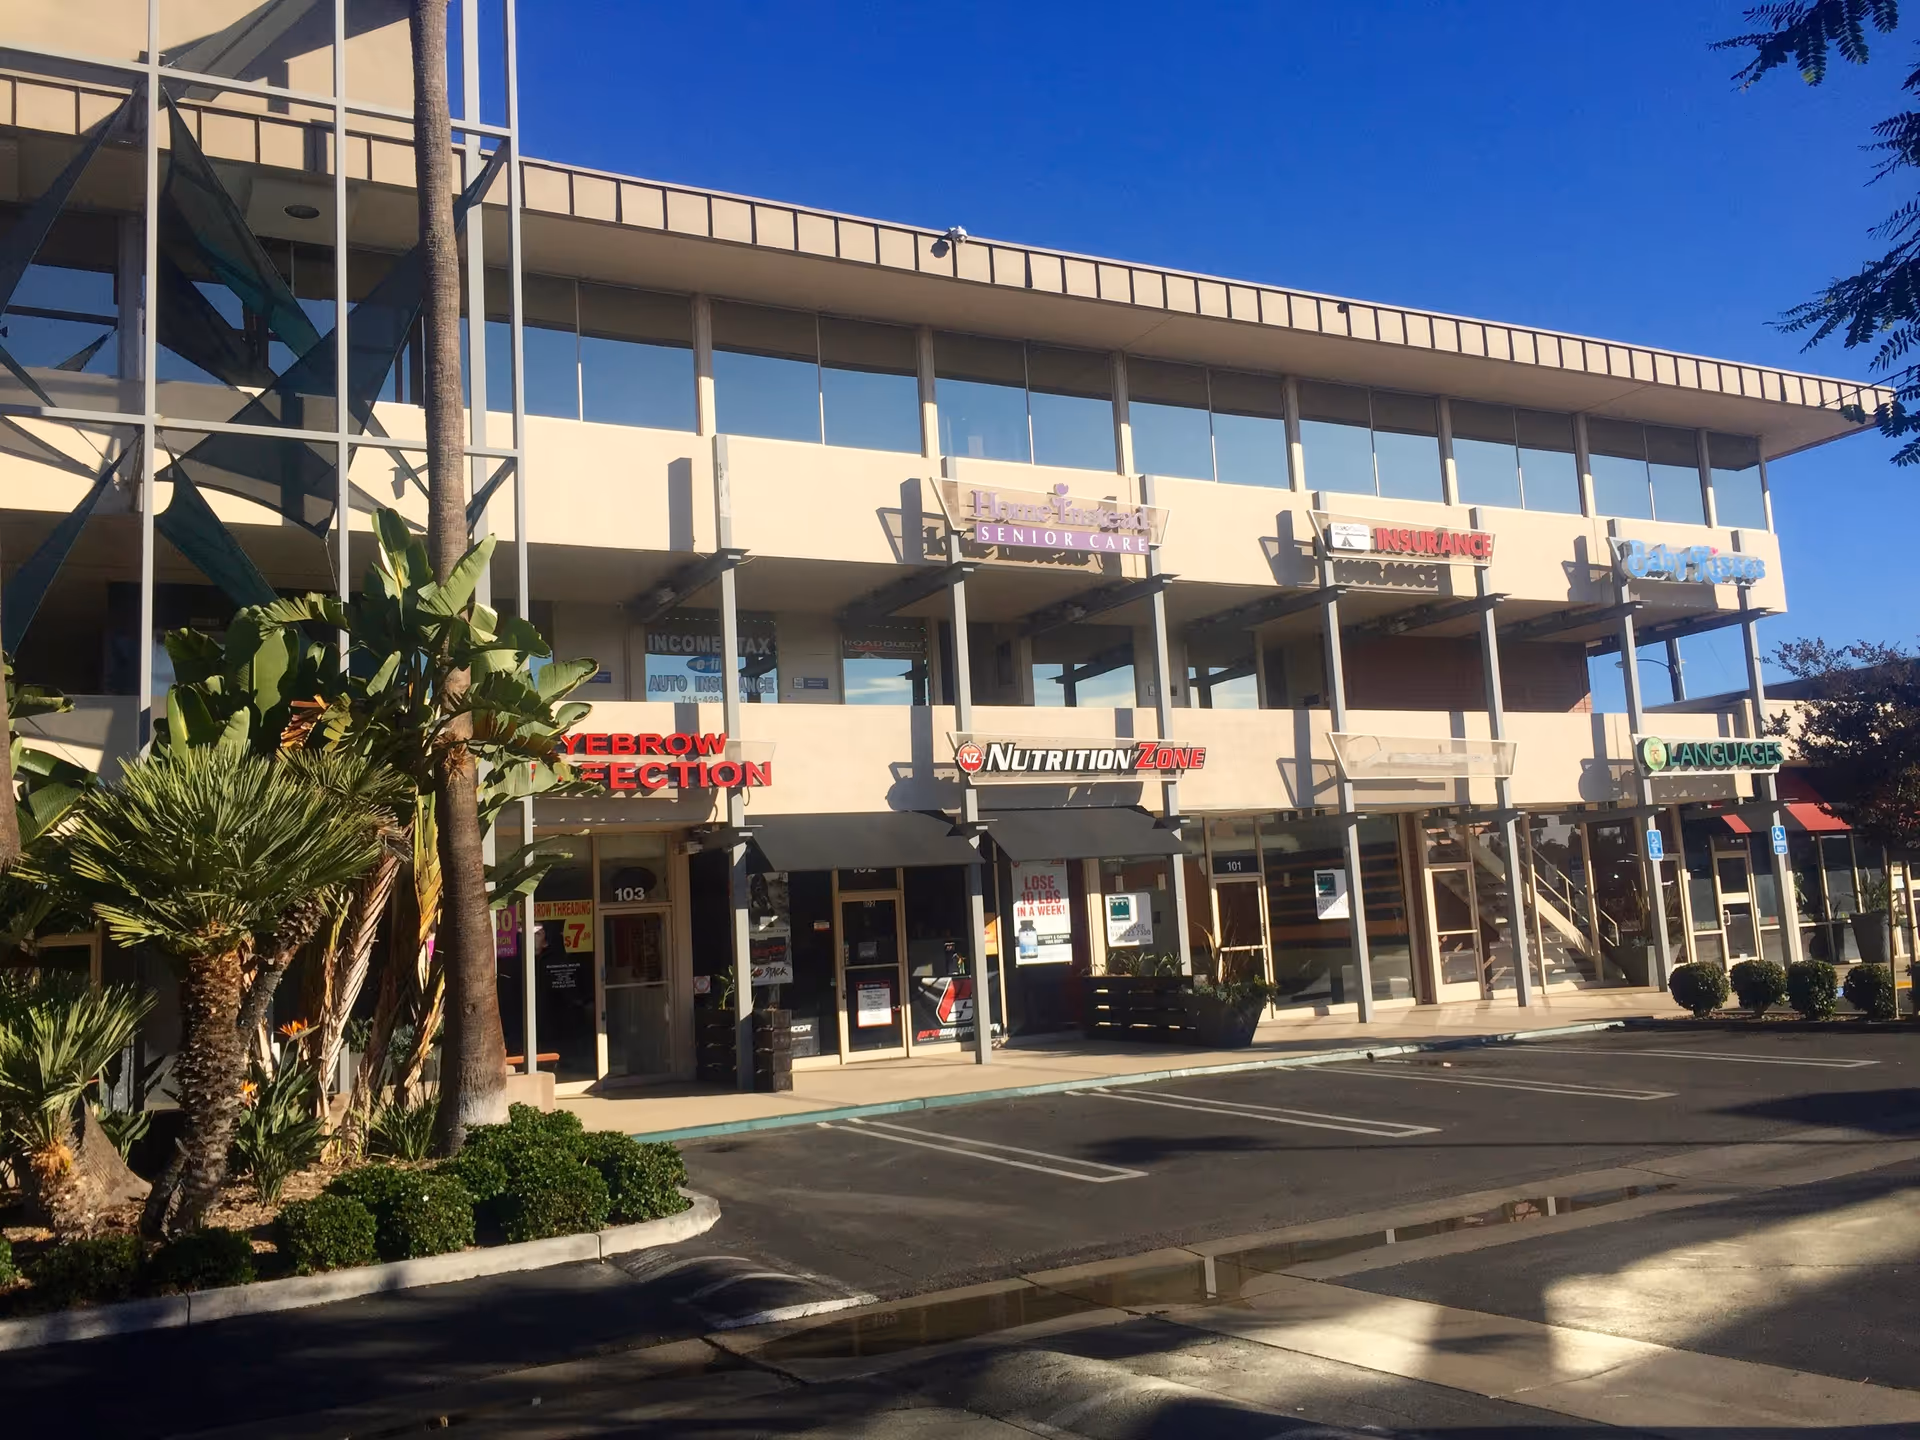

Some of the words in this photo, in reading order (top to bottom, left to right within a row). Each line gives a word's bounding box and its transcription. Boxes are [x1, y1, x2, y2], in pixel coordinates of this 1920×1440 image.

[971, 489, 1051, 523] Home
[1051, 483, 1150, 530] Instead
[982, 526, 1073, 547] SENIOR
[1089, 534, 1145, 552] CARE
[1374, 527, 1492, 557] INSURANCE
[1627, 540, 1688, 582] Baby
[1690, 545, 1766, 584] Kisses
[647, 633, 722, 654] INCOME
[737, 636, 771, 655] TAX
[648, 674, 688, 692] AUTO
[694, 676, 775, 694] INSANCE
[560, 732, 727, 756] YEBROW
[1667, 741, 1785, 767] LANGUAGES
[962, 753, 980, 764] NZ
[988, 742, 1132, 772] NUTRITION
[1133, 741, 1207, 770] ZONE
[1226, 860, 1242, 872] 101
[1024, 875, 1055, 890] LOSE
[614, 887, 645, 902] 103
[1021, 890, 1034, 906] 10
[1038, 889, 1061, 905] LBS
[553, 901, 591, 917] THREADING
[1017, 907, 1026, 917] IN
[1029, 906, 1035, 917] A
[1037, 904, 1066, 917] WEEK!
